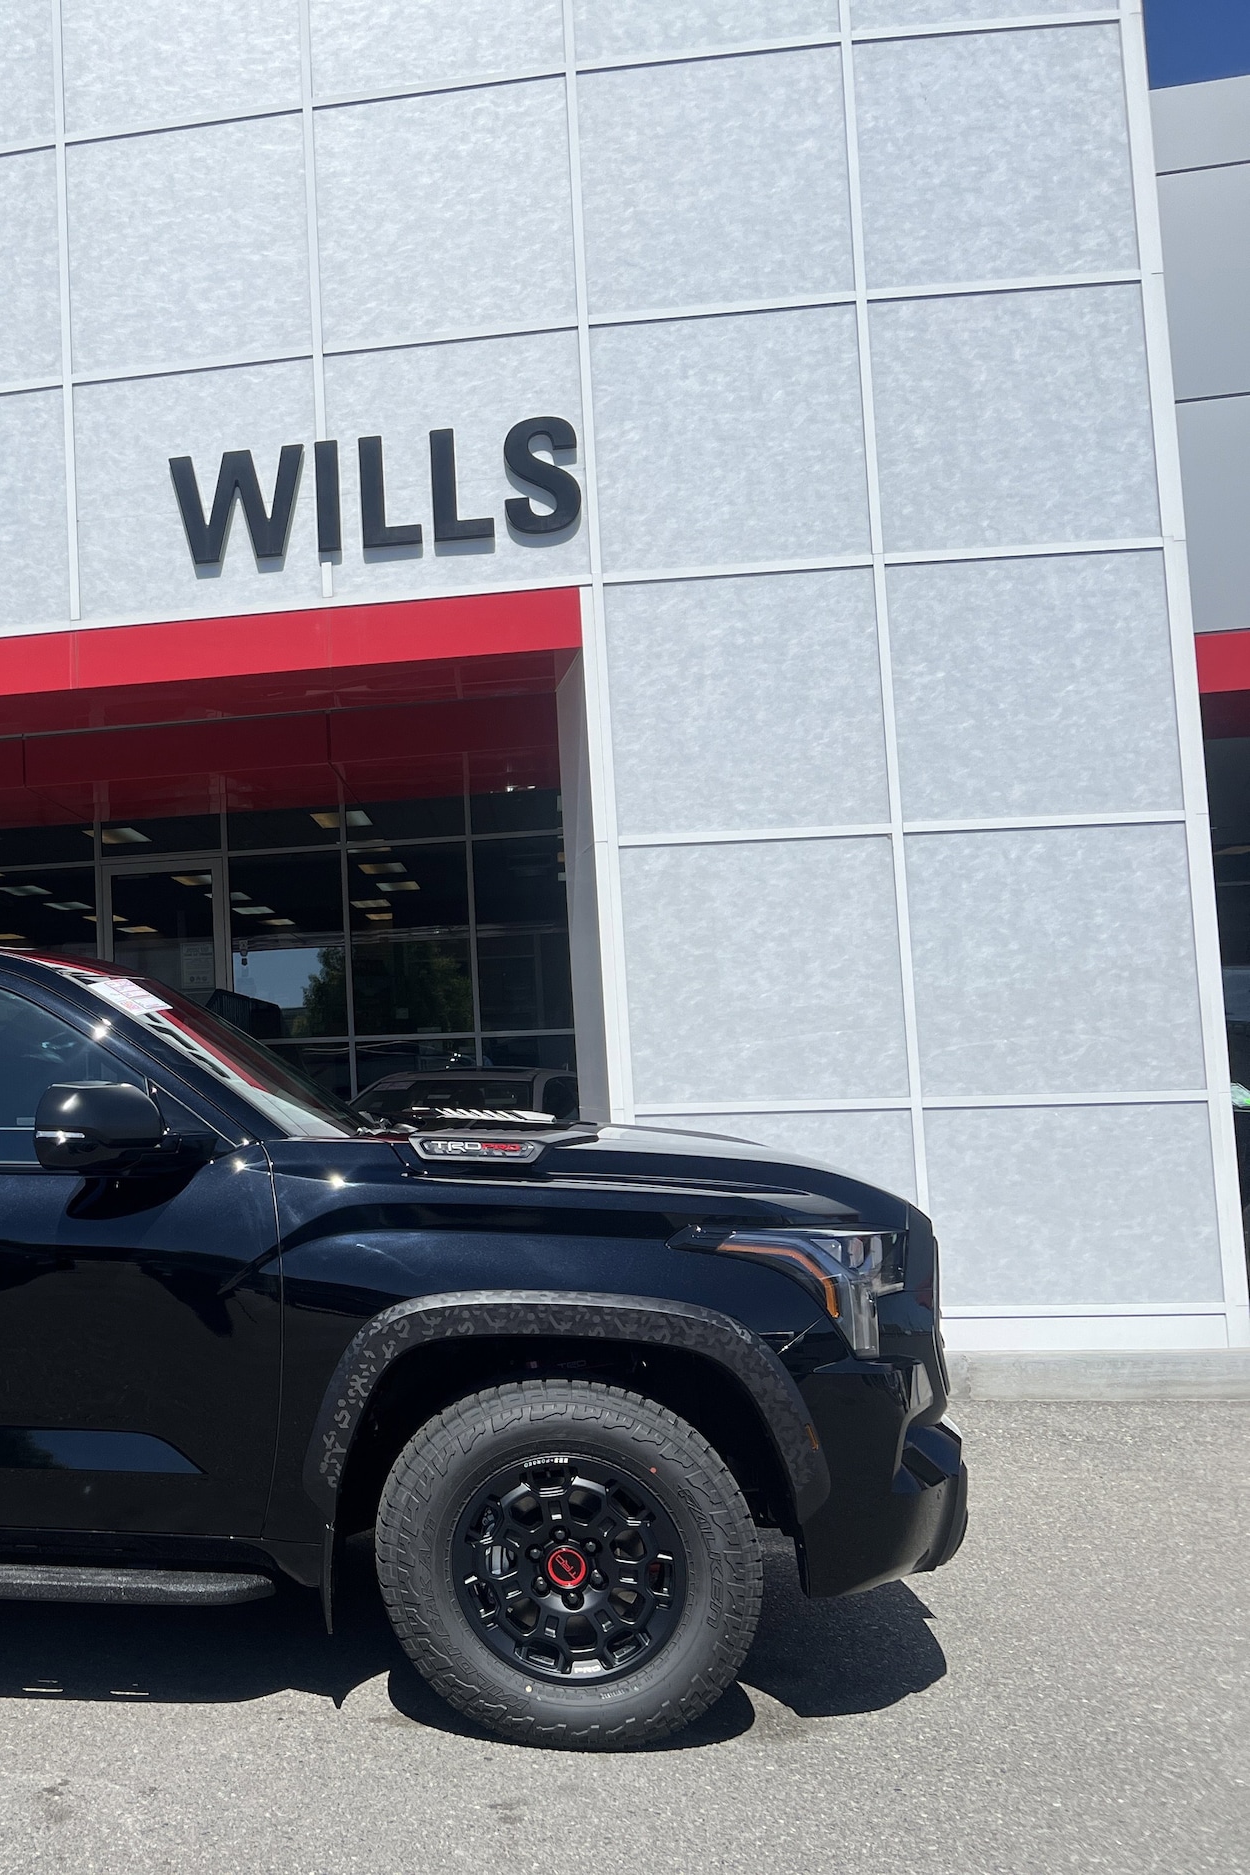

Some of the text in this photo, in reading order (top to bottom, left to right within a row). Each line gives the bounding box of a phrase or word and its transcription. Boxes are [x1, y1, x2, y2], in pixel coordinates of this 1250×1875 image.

[169, 416, 582, 564] WILLS
[431, 1141, 521, 1153] TRD PRO
[555, 1554, 578, 1580] TRD
[677, 1484, 724, 1630] FALKEN
[573, 1664, 601, 1674] PRO
